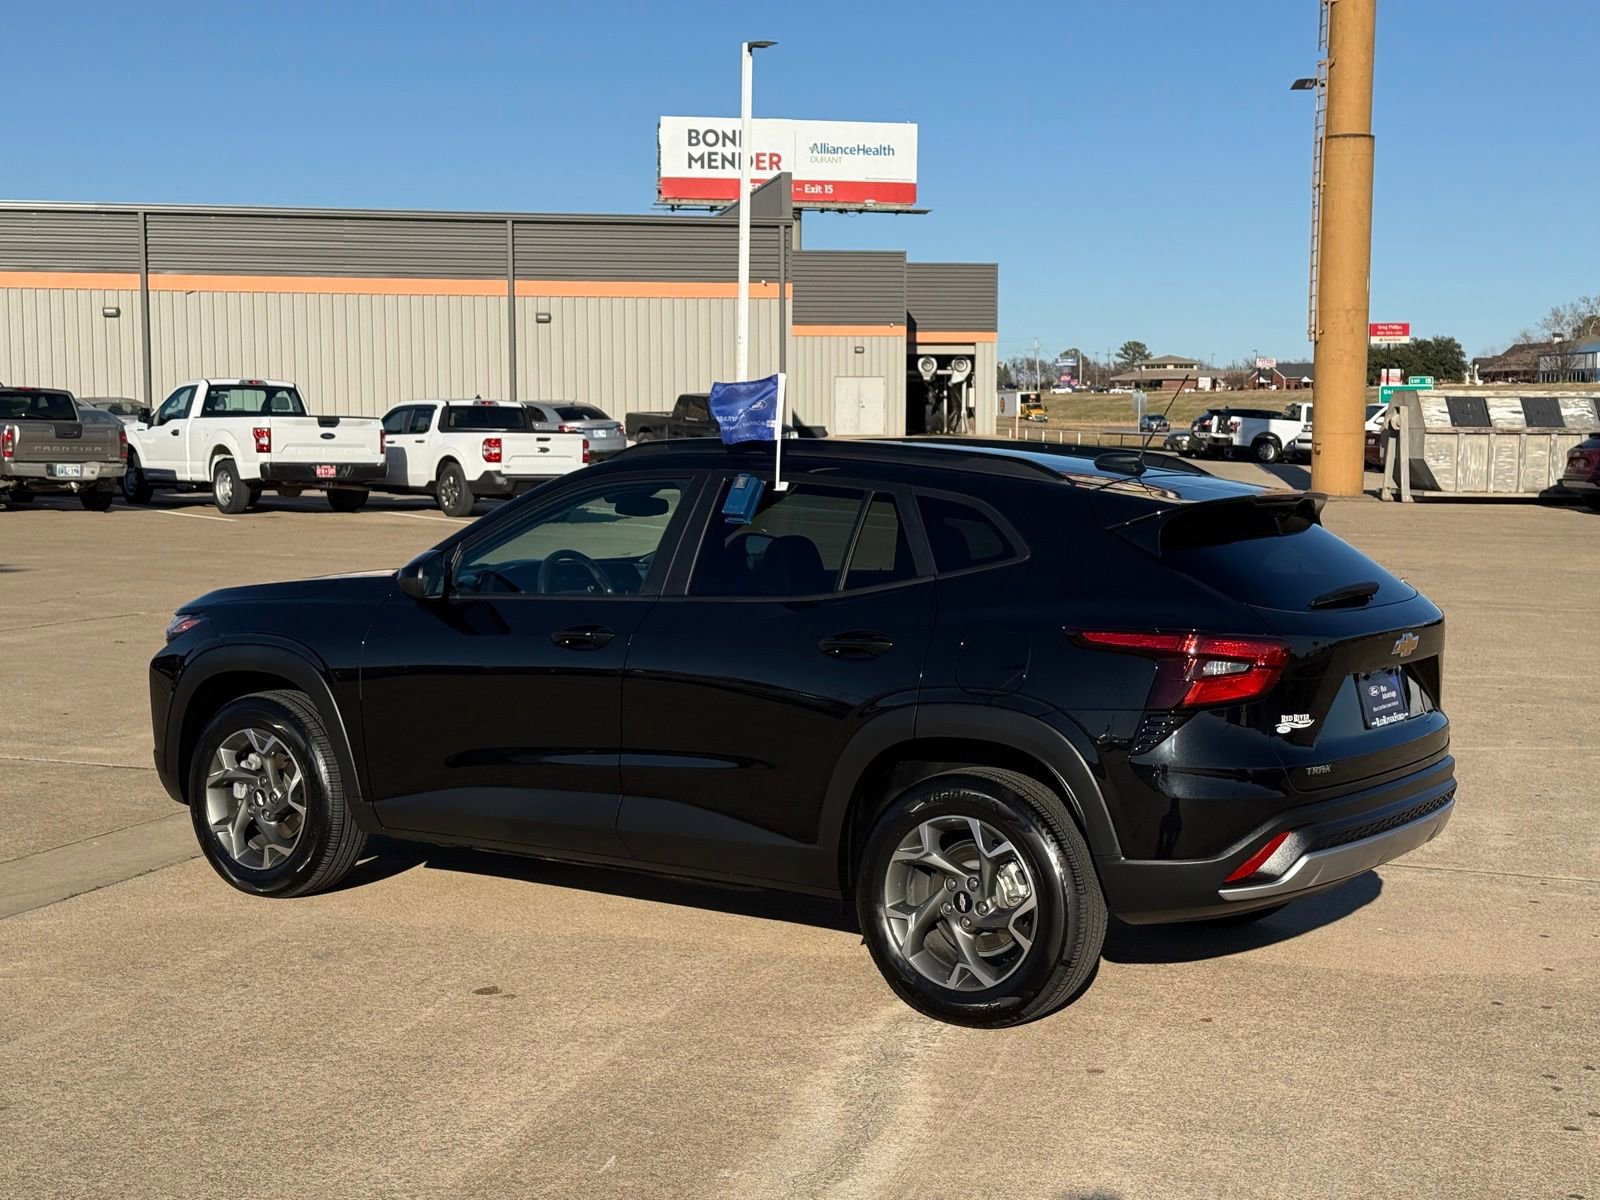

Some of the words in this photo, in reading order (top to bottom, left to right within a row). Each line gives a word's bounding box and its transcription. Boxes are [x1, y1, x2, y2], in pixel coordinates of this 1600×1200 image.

[808, 142, 895, 156] AllianceHealth
[809, 156, 842, 164] DURANT
[804, 184, 822, 194] Exit
[824, 185, 834, 194] 15
[1305, 764, 1331, 776] TRAX
